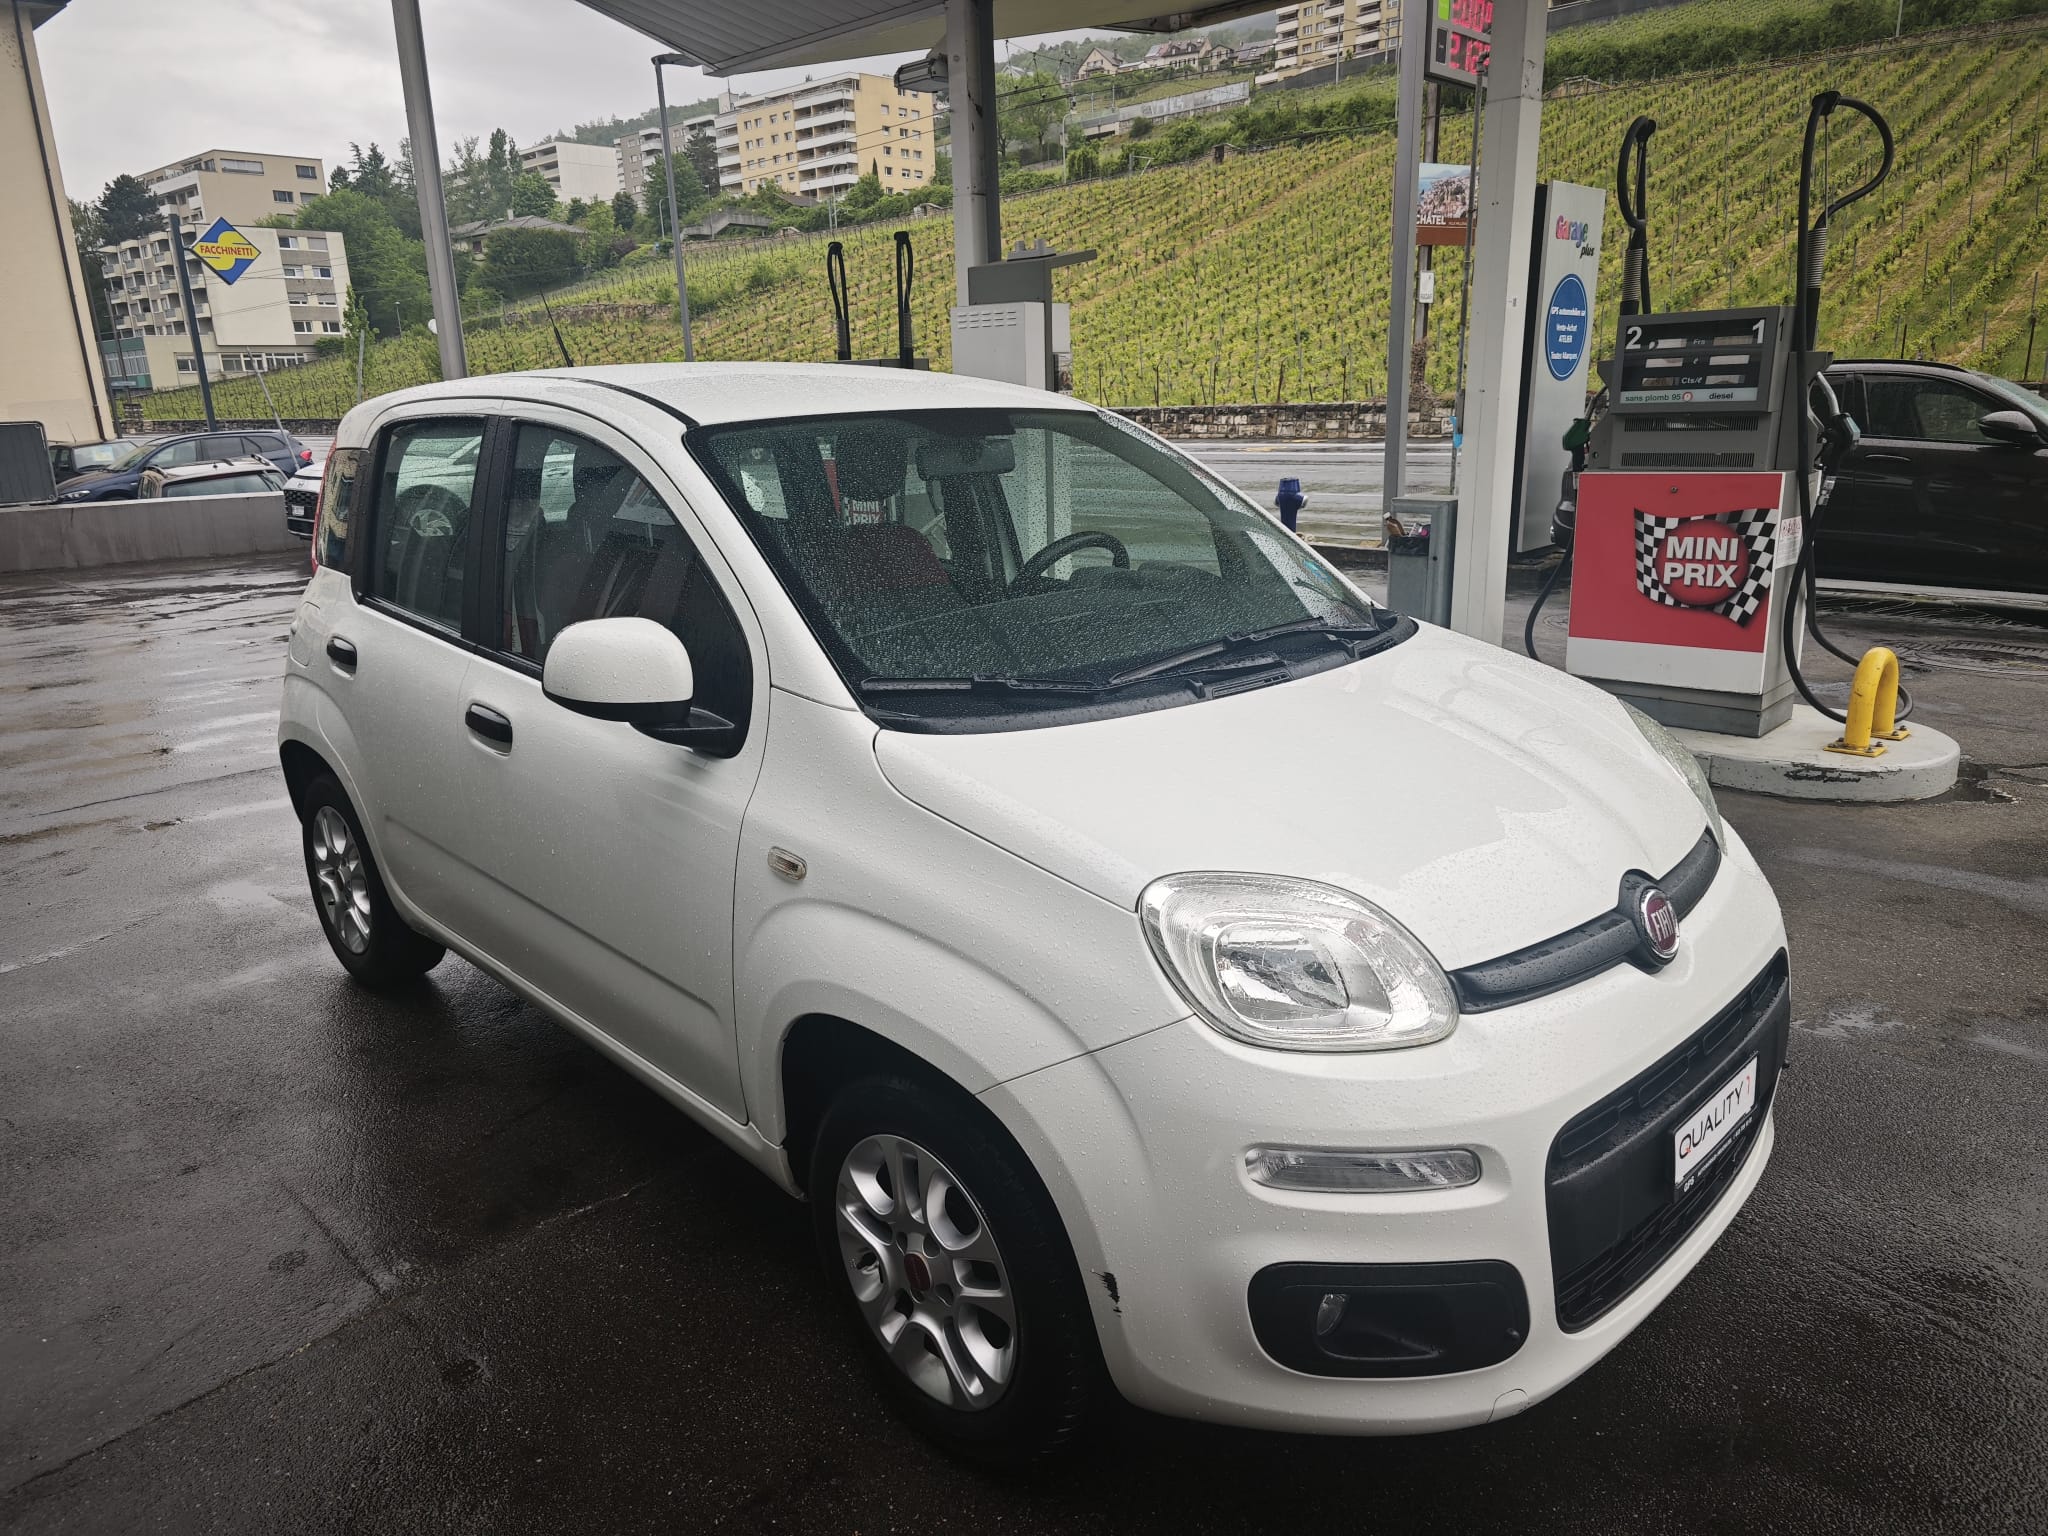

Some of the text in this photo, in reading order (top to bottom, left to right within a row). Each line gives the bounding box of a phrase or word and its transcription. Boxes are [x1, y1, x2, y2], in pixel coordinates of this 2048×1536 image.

[1556, 215, 1589, 248] Garage
[200, 245, 253, 257] FACCHINETTI
[1580, 243, 1595, 259] plus
[1625, 319, 1765, 350] 2 1
[1645, 394, 1669, 402] plomb
[1671, 393, 1682, 401] 95
[1709, 392, 1734, 400] diesel
[1666, 536, 1738, 561] MINI
[1663, 562, 1738, 588] PRIX
[1650, 905, 1674, 942] FIAT
